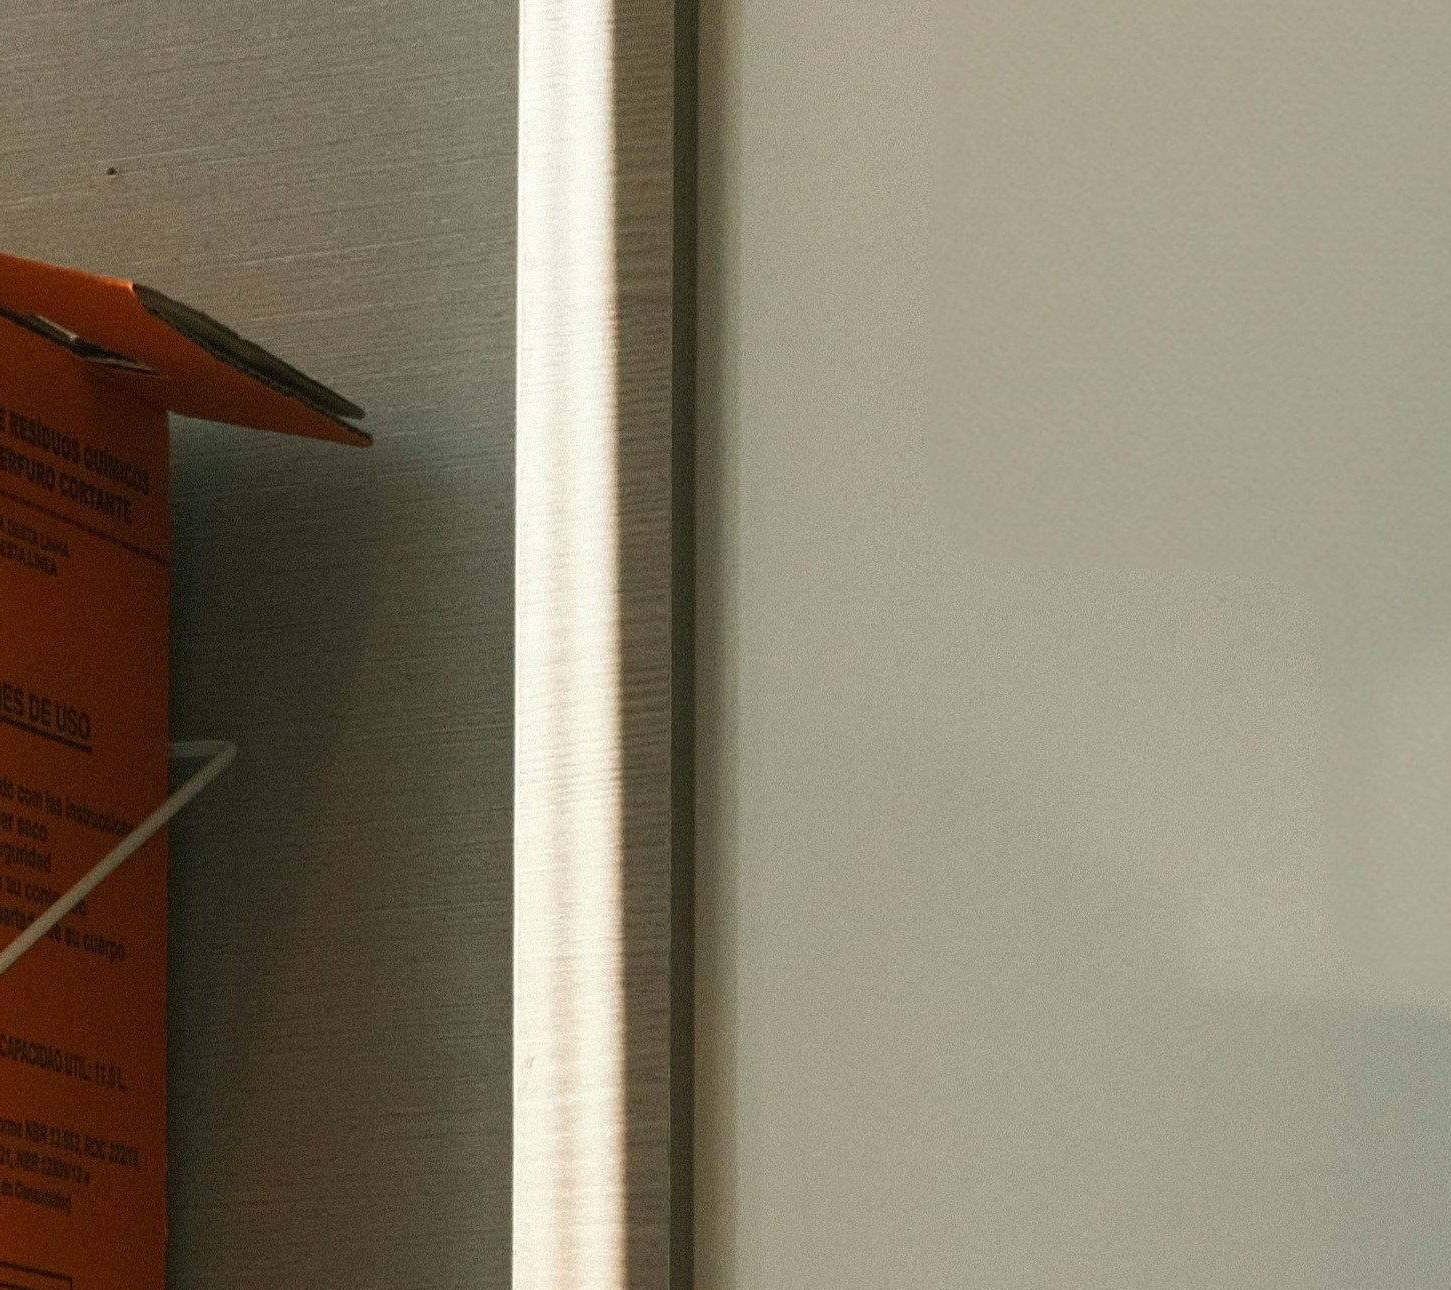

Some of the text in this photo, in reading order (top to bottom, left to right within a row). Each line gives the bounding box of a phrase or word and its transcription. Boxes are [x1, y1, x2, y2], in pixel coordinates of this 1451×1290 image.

[9, 411, 80, 464] RESÍDUOS
[28, 692, 52, 728] DE
[55, 702, 92, 741] USO
